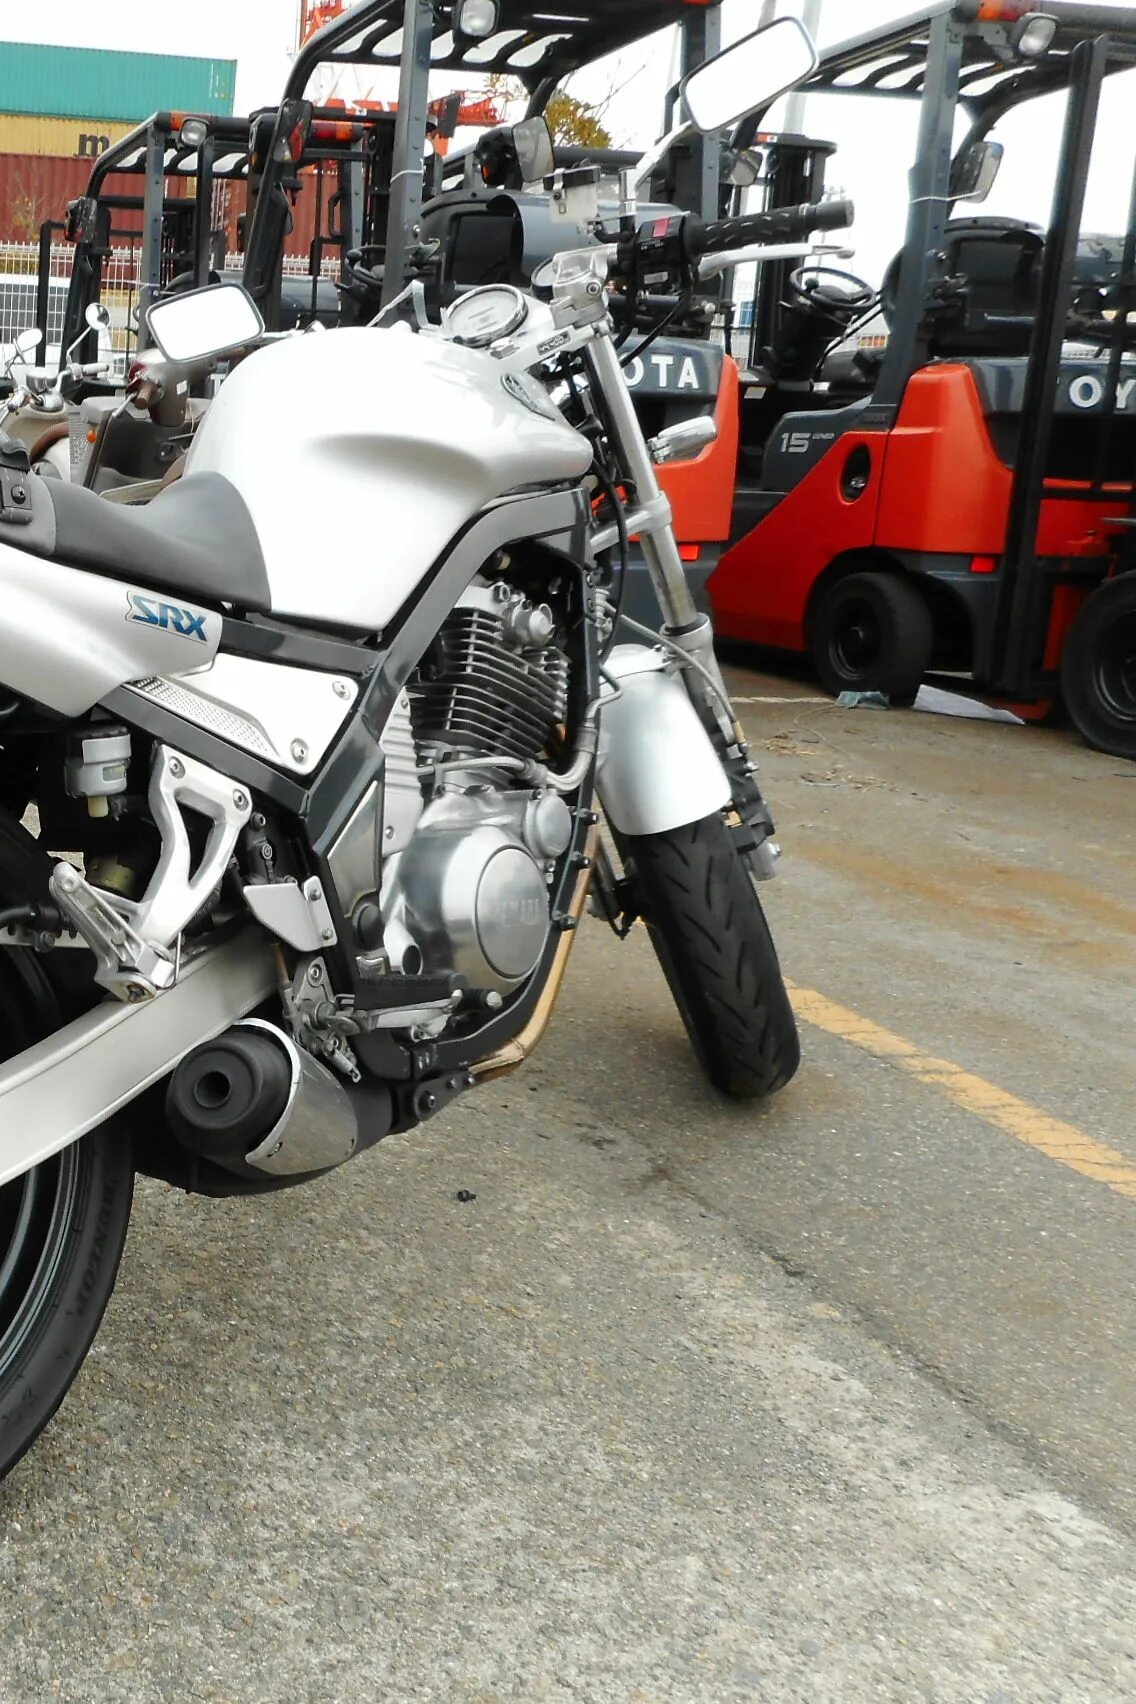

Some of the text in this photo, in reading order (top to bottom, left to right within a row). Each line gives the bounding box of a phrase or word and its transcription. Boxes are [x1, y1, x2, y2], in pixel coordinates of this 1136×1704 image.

[619, 352, 701, 391] OTA
[1068, 375, 1136, 410] OY
[781, 432, 811, 453] 15
[131, 593, 209, 643] SRX
